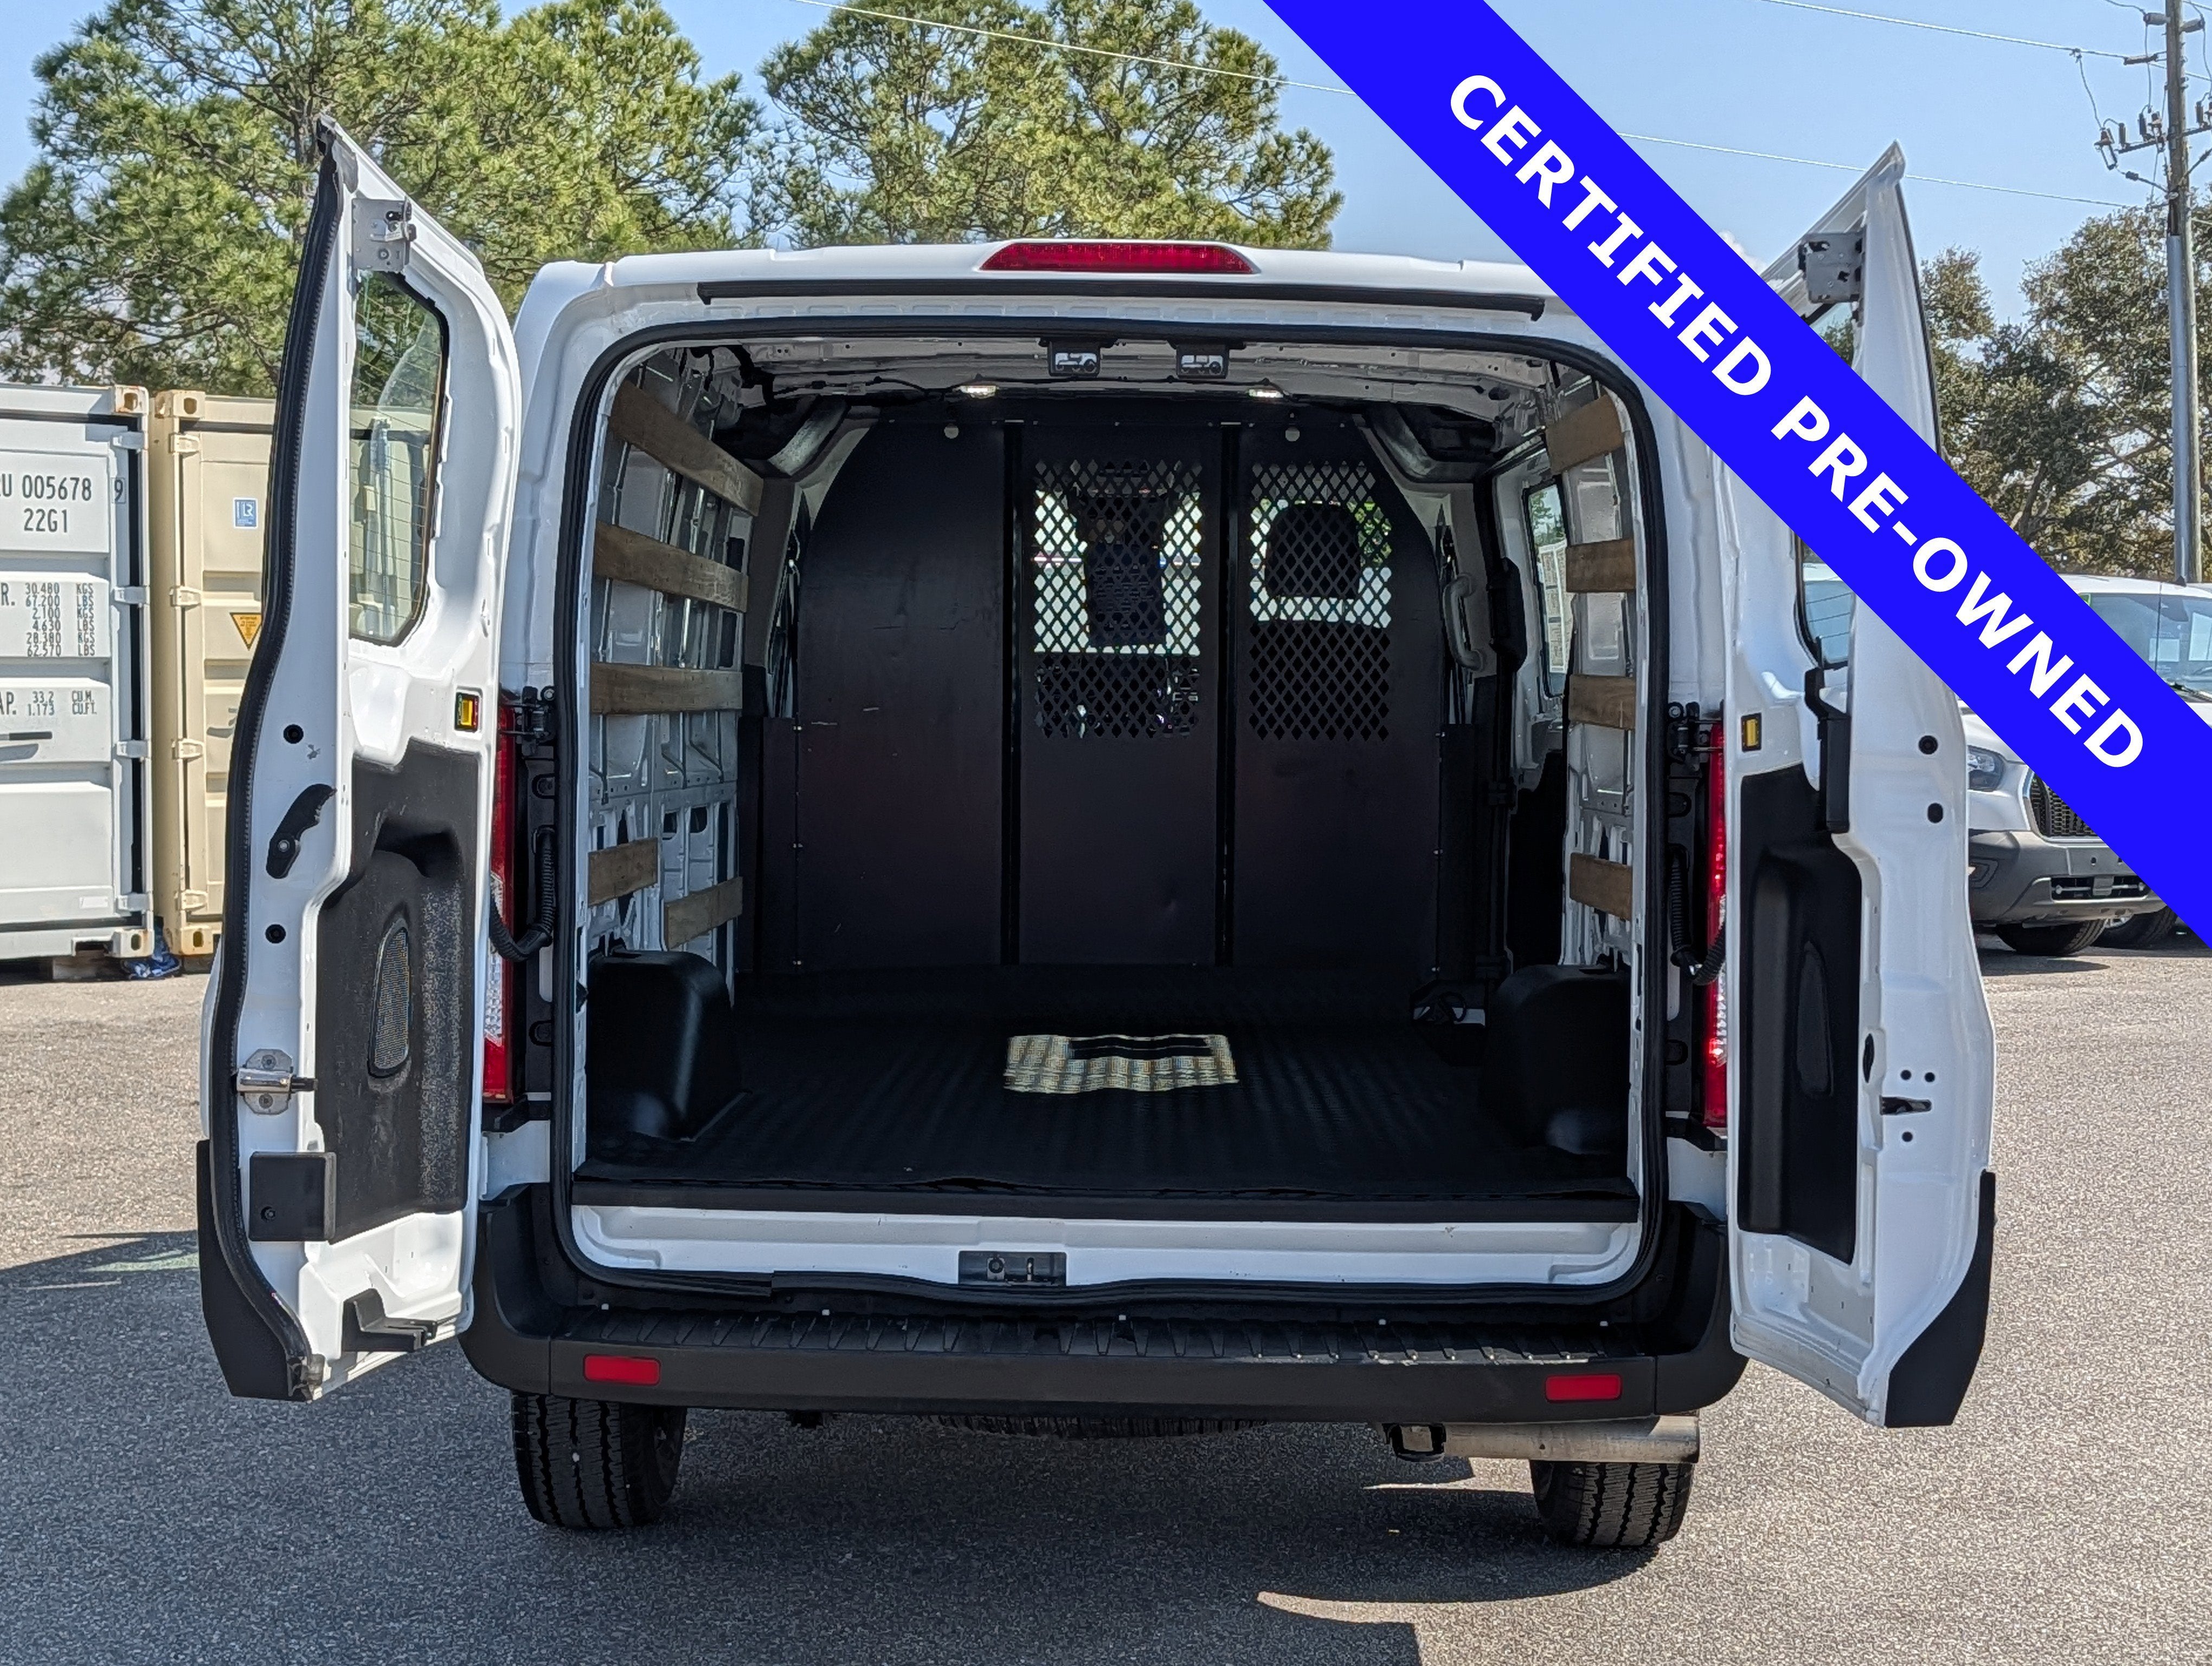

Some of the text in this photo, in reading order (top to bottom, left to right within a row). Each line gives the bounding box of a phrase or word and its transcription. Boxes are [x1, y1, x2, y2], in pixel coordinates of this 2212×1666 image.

[0, 473, 124, 502] U 005678 9
[24, 508, 68, 533] 22G1
[76, 583, 94, 594] KGS
[77, 595, 94, 607] LBS
[77, 607, 94, 619] KGS
[78, 619, 95, 631] LBS
[78, 632, 95, 644] KGS
[78, 644, 95, 656] LBS
